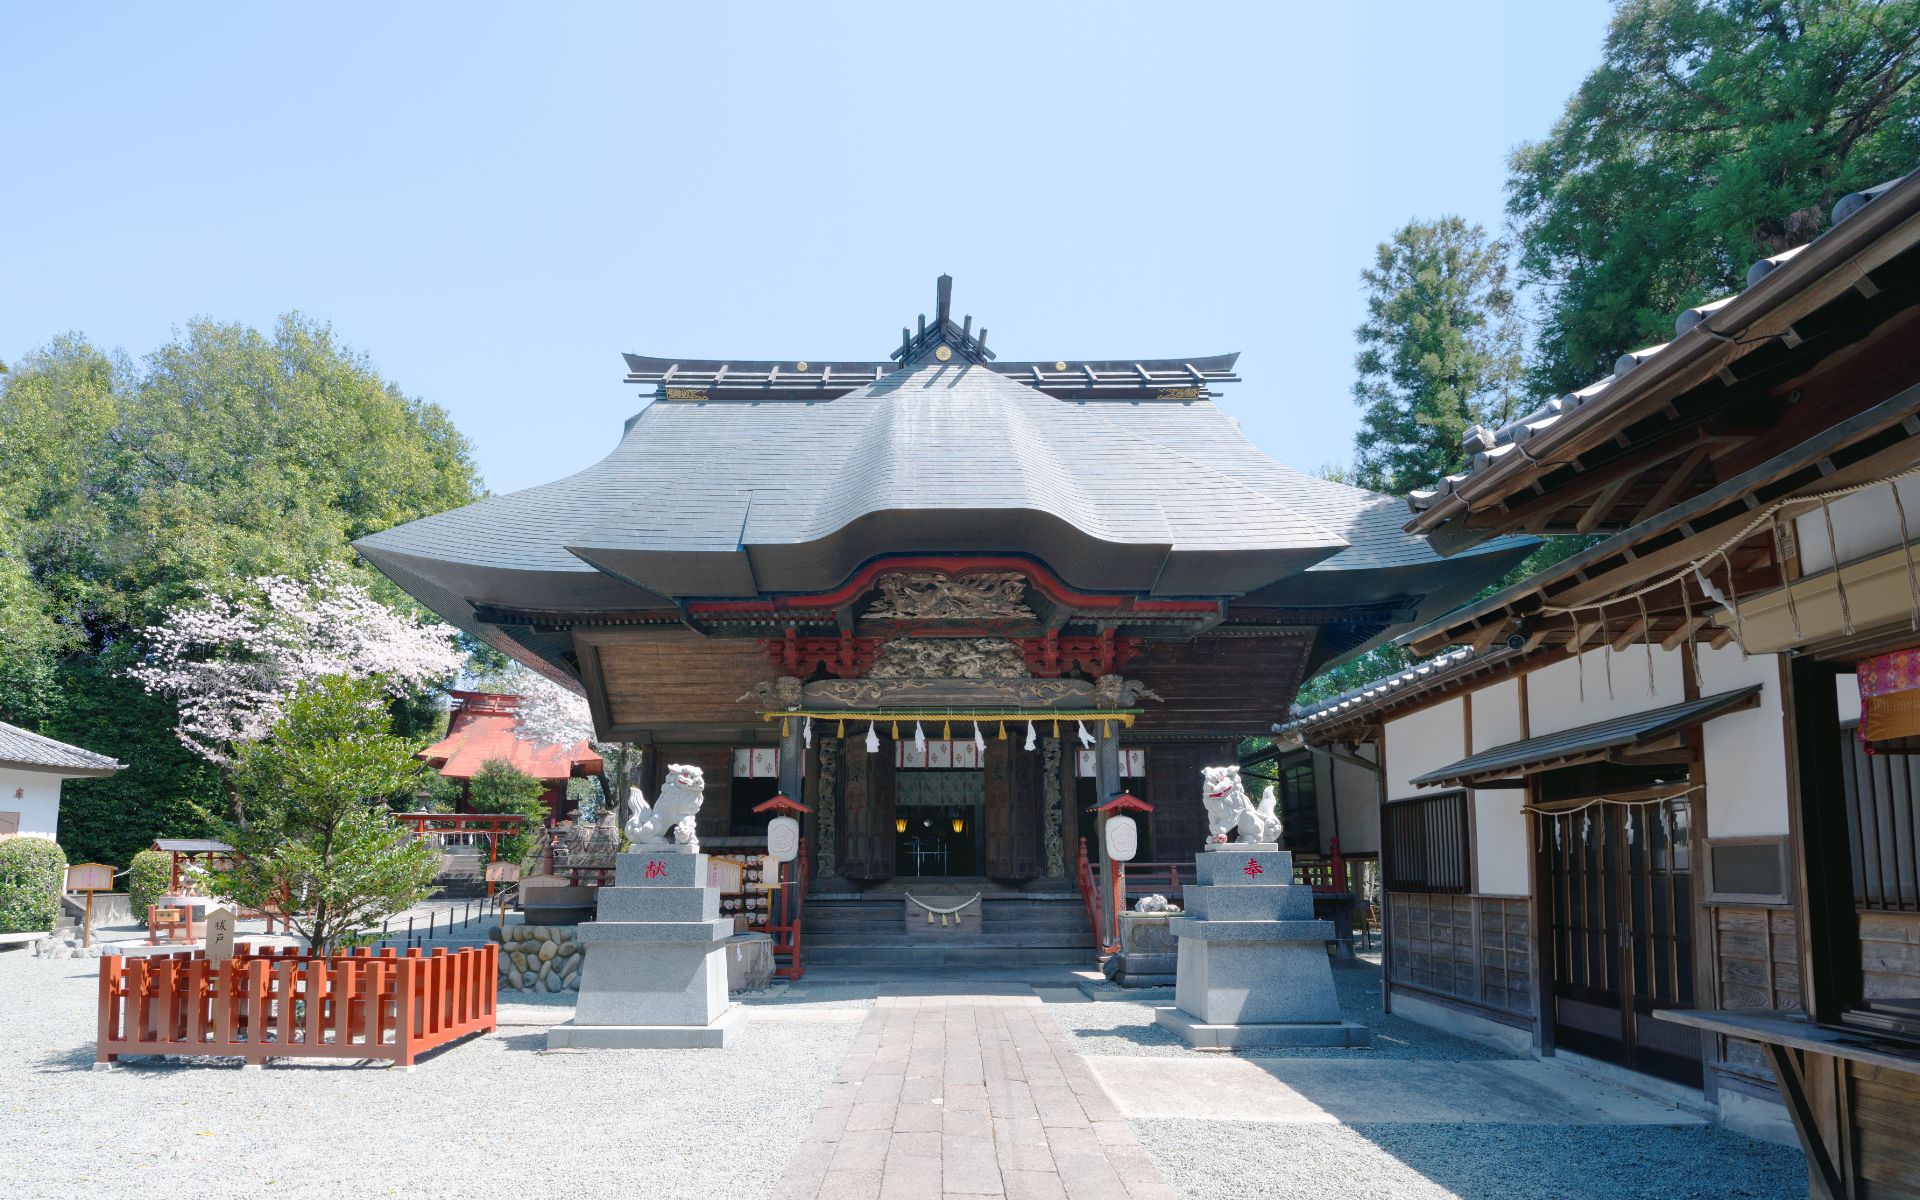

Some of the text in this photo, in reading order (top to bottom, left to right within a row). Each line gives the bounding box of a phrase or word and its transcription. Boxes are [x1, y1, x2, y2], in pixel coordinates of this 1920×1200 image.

[645, 860, 667, 880] 献
[1243, 857, 1263, 880] 奉
[214, 919, 227, 944] 祓戸
